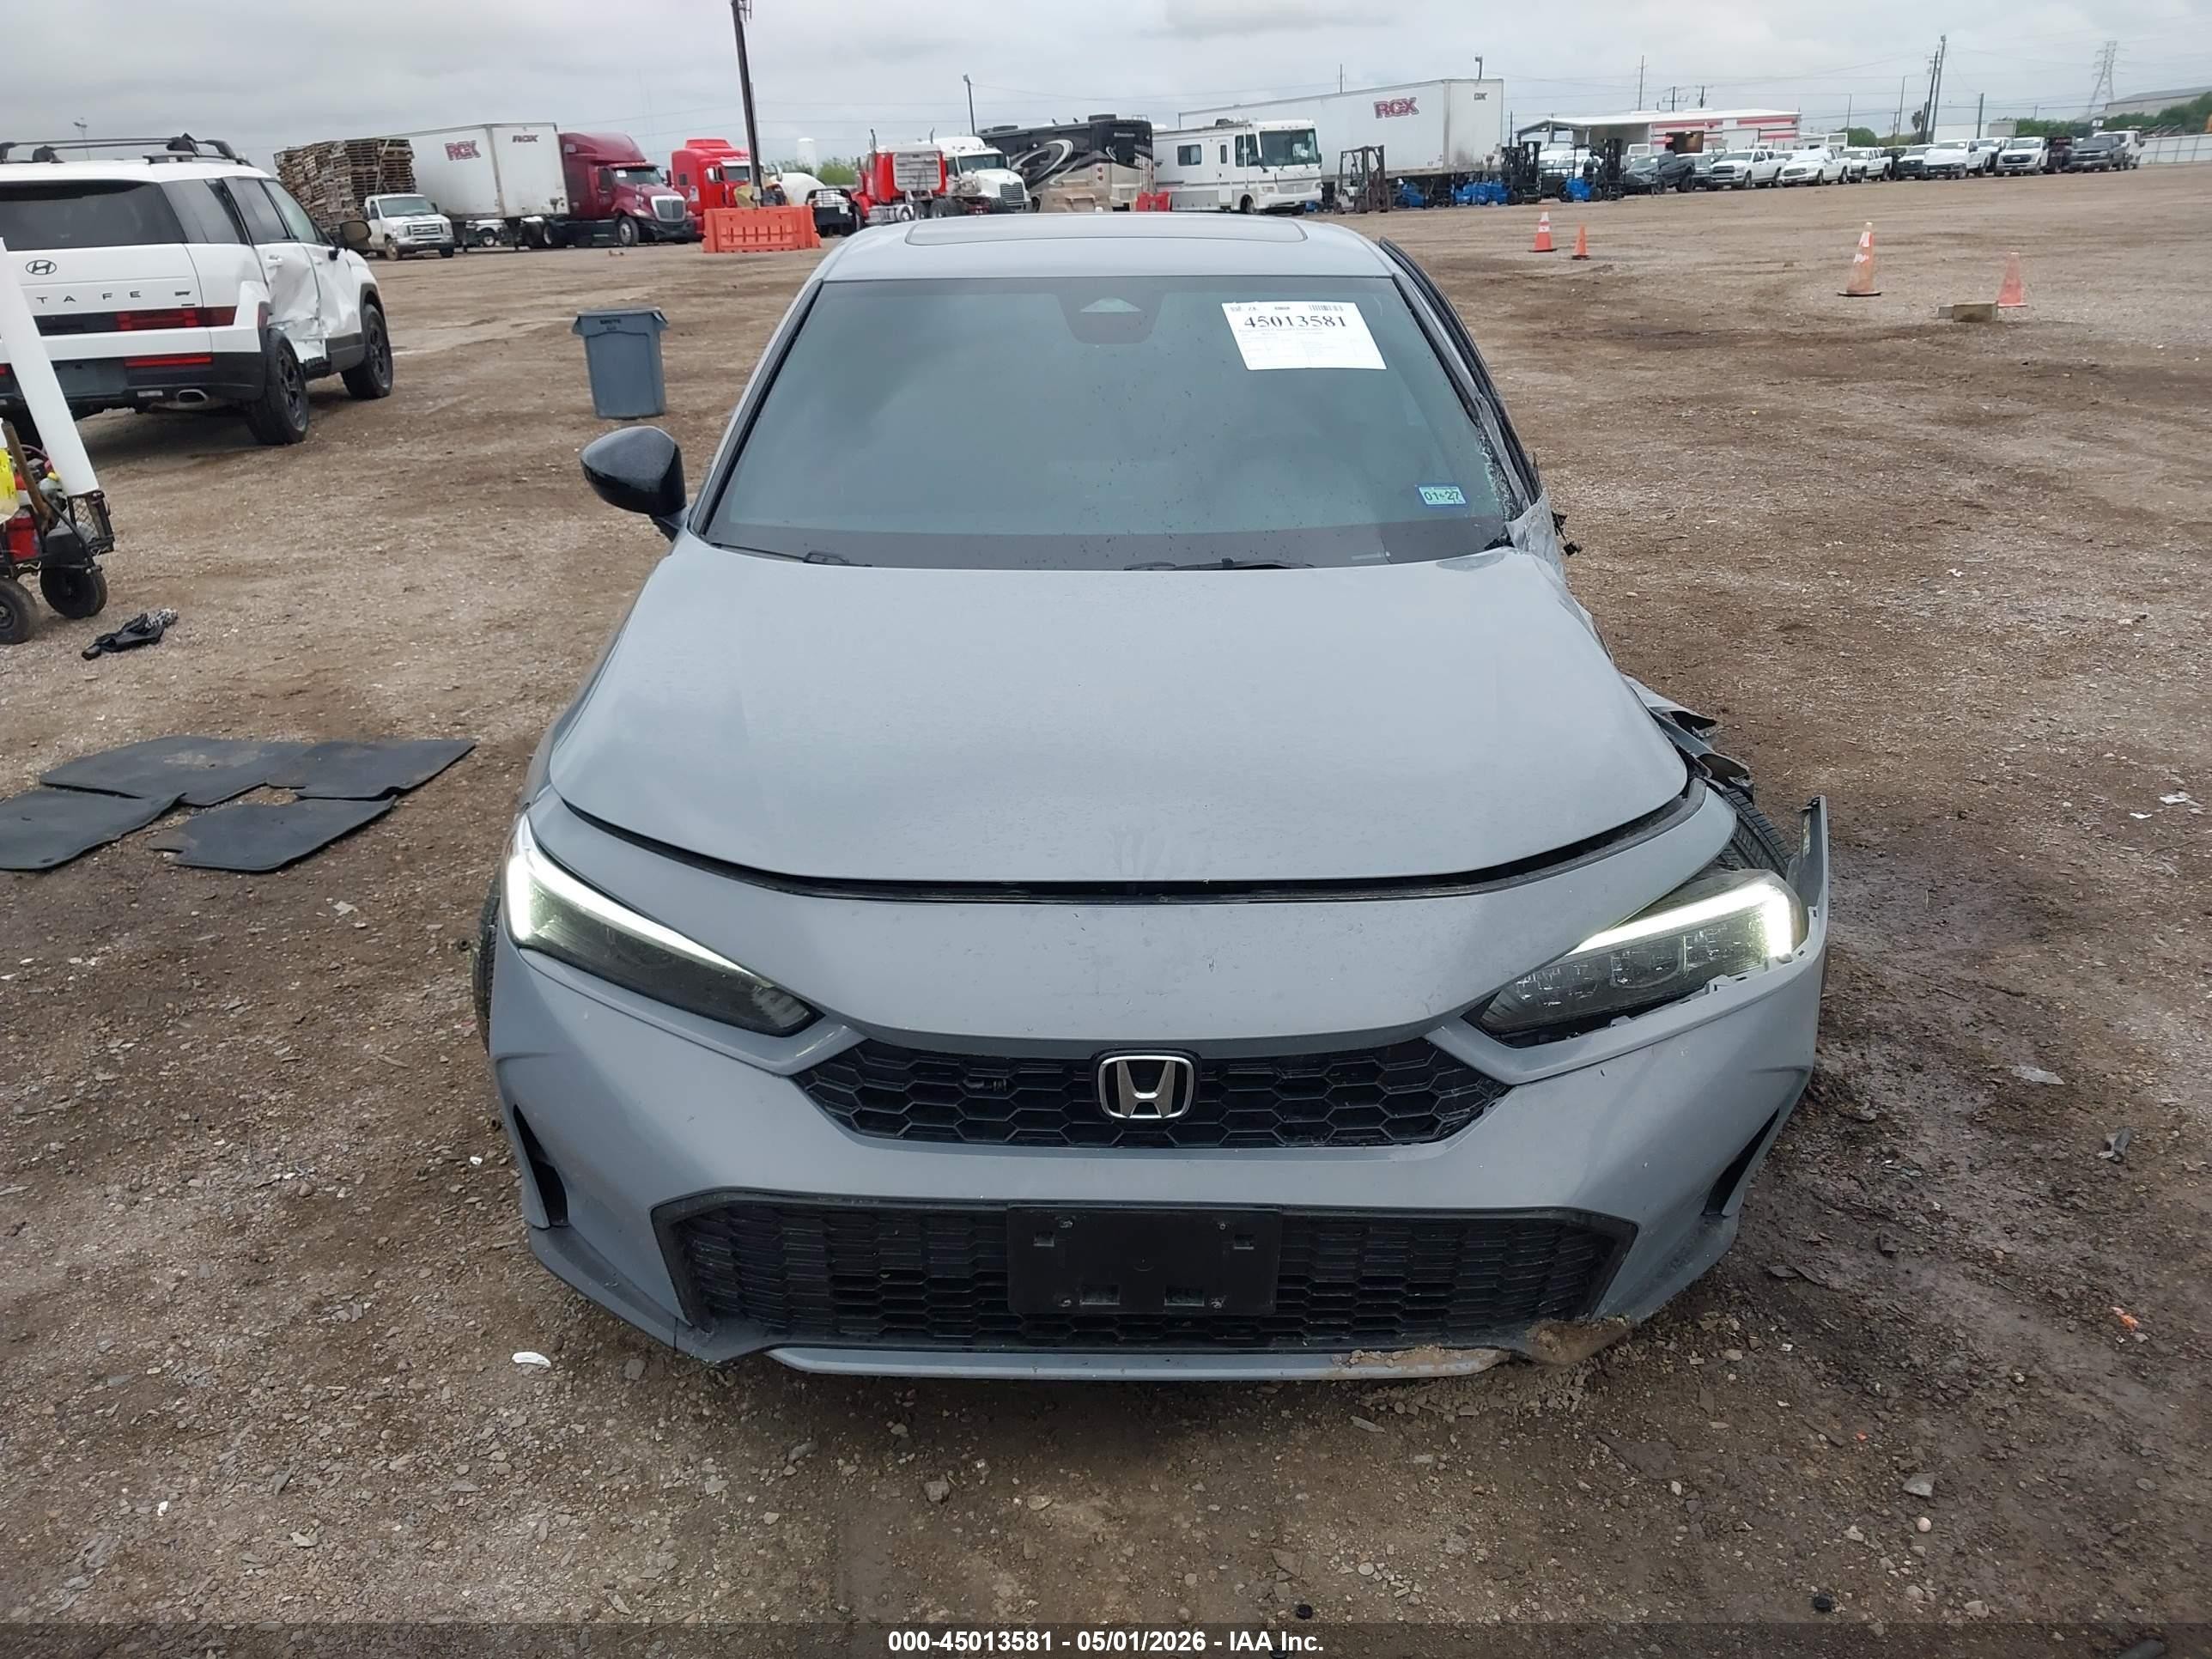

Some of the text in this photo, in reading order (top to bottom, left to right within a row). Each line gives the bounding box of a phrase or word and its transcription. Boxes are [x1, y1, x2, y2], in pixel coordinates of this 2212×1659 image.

[1374, 97, 1419, 118] RCX
[102, 290, 141, 301] FE
[1244, 315, 1346, 328] 45013581
